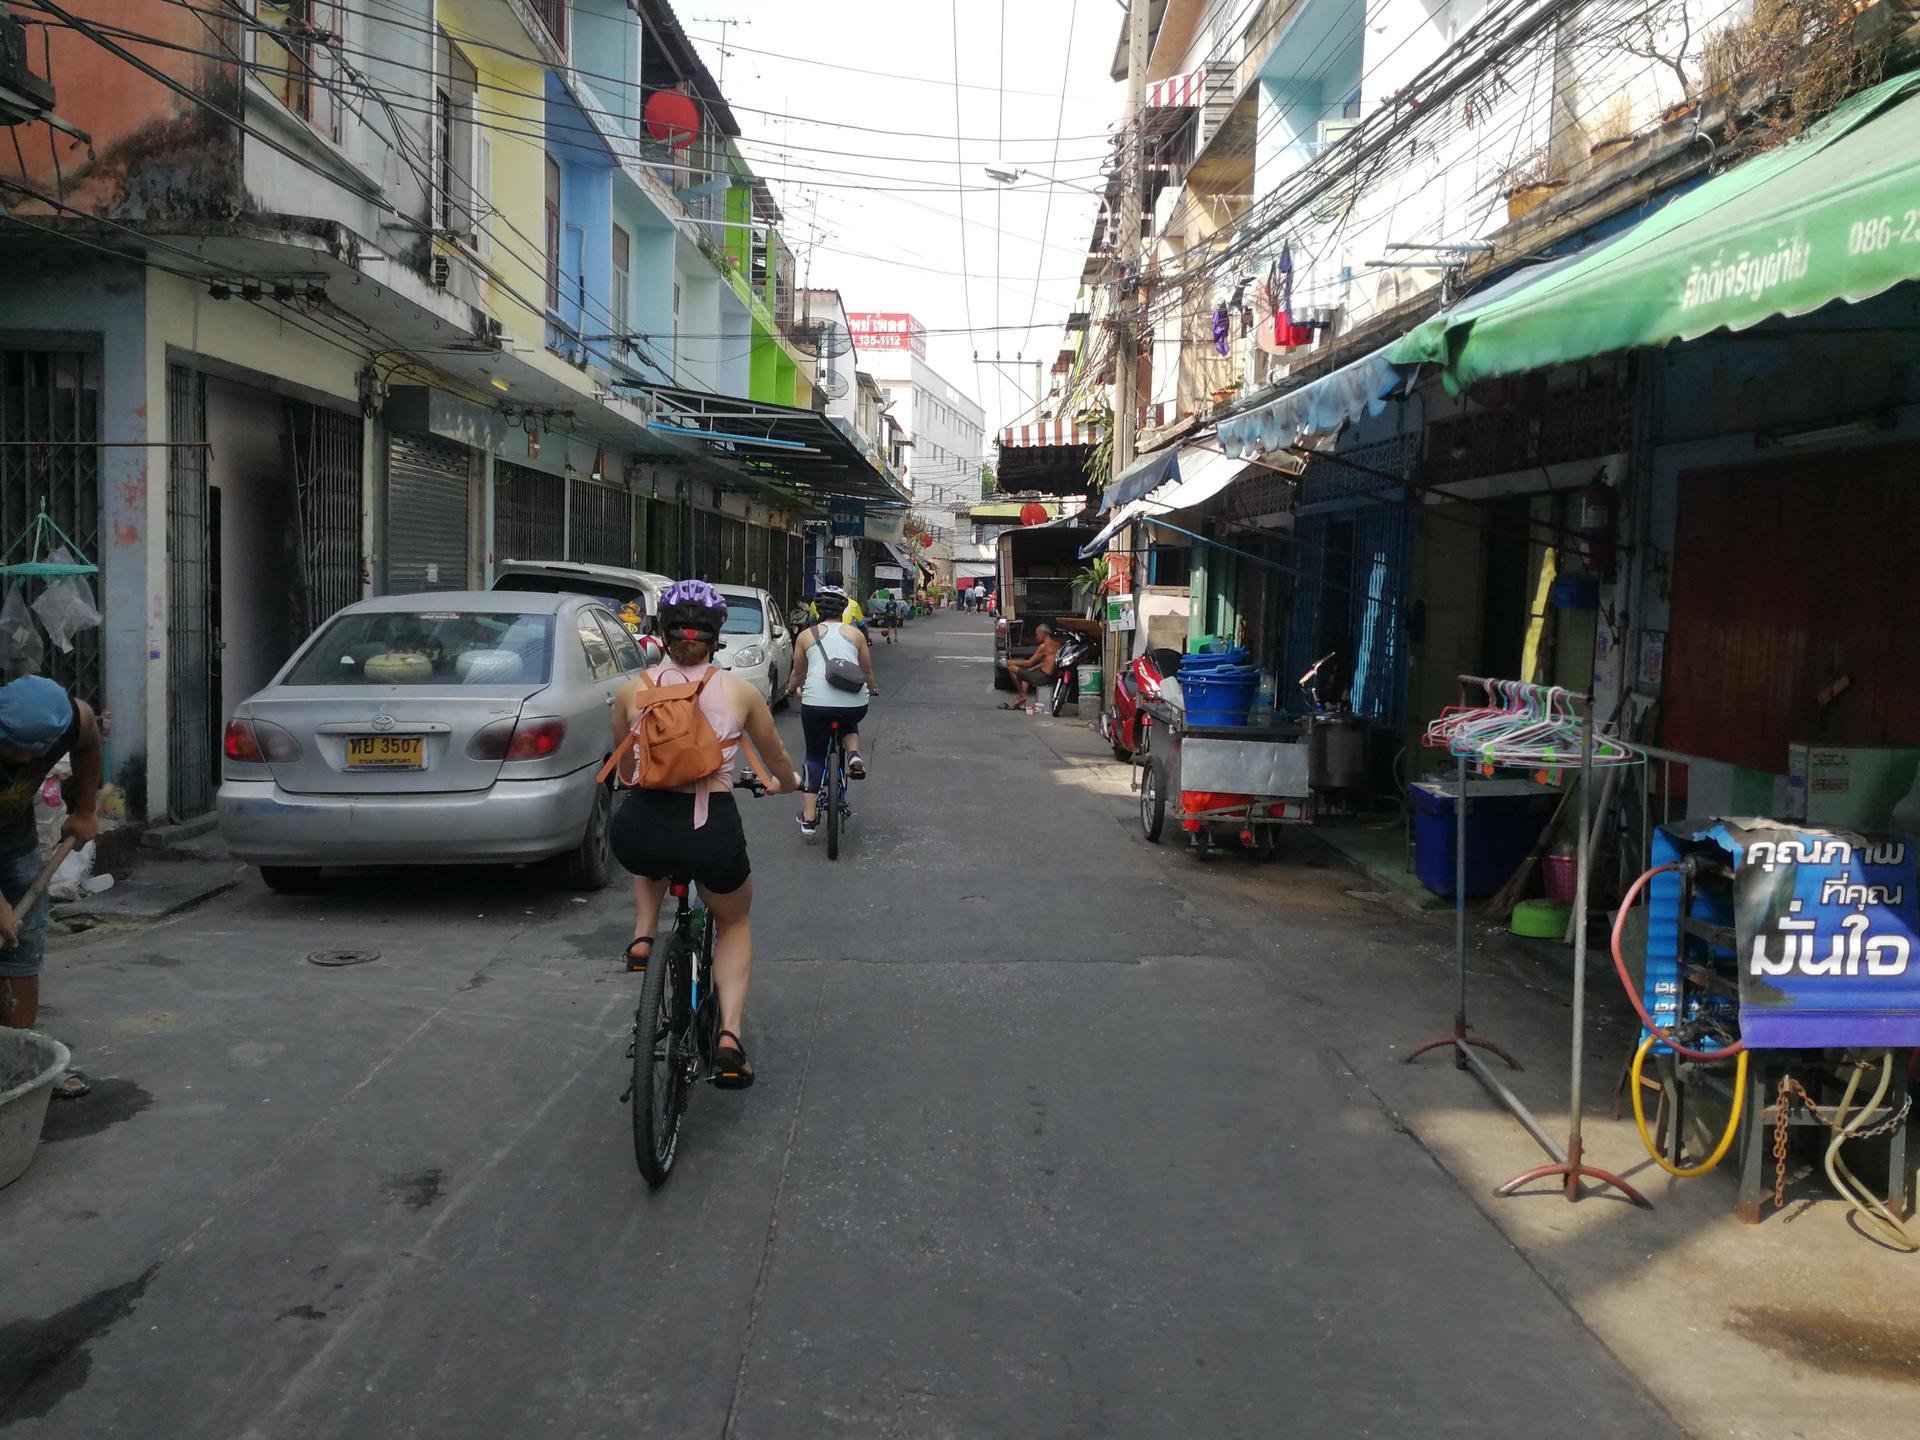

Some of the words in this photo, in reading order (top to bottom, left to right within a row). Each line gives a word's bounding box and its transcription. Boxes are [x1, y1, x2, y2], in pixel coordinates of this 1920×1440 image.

[1848, 208, 1920, 255] 086-2
[380, 738, 421, 753] 3507
[1747, 841, 1905, 872] คุณภาพ
[1821, 872, 1902, 911] ที่คุณ
[1750, 900, 1910, 976] มั่นใจ
